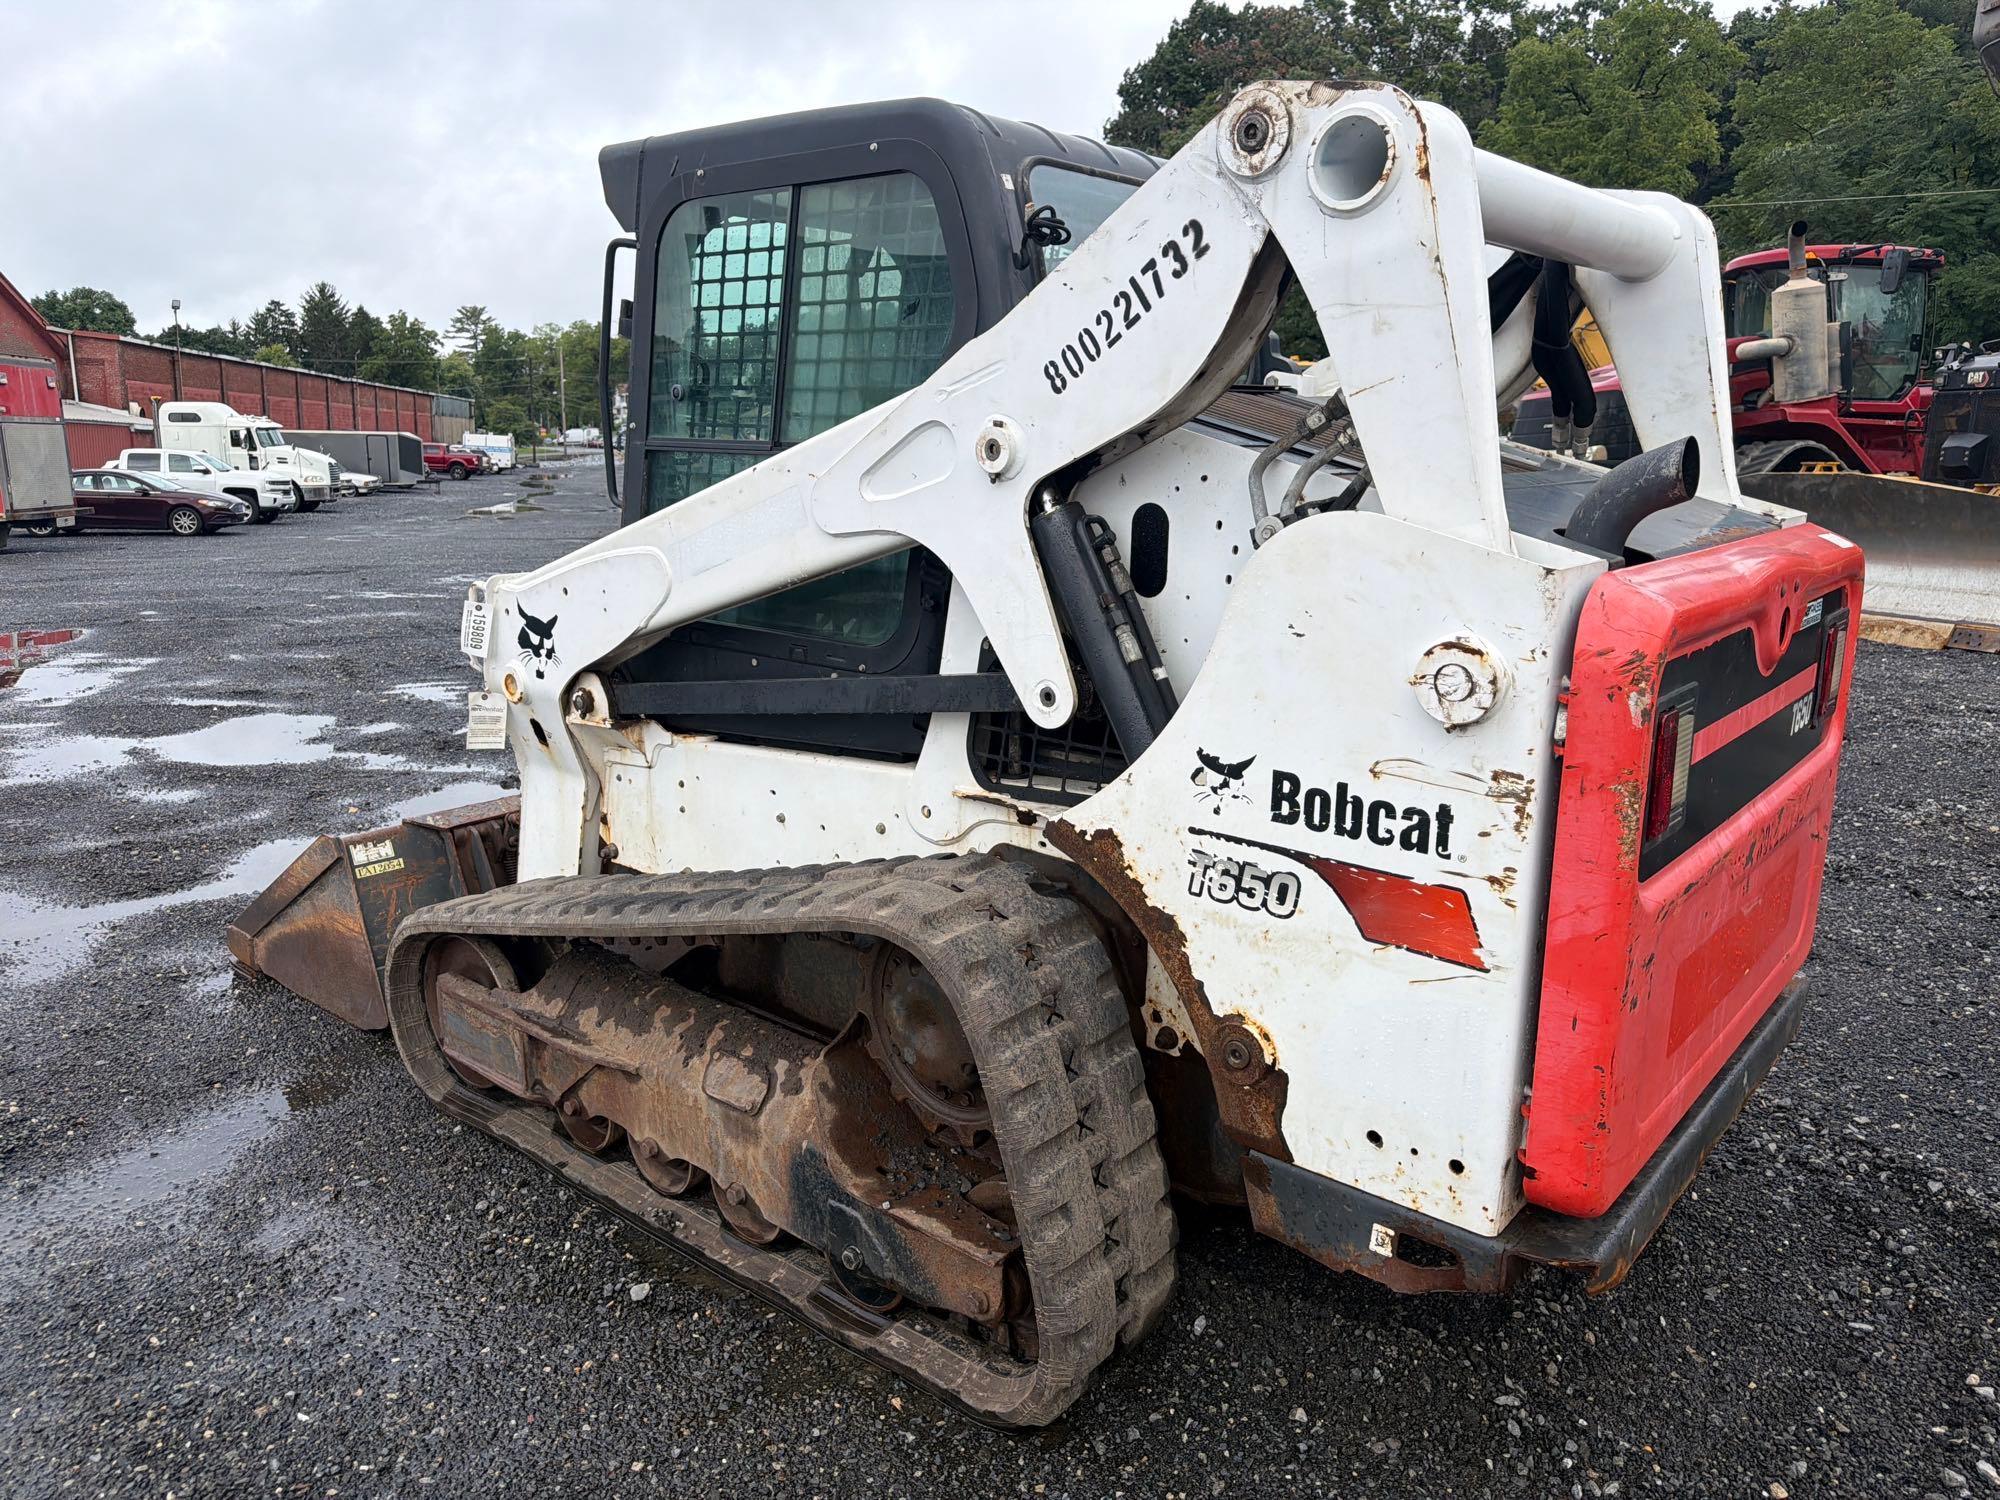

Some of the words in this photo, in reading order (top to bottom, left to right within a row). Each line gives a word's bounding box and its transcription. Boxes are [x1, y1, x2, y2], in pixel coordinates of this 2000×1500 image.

[1043, 218, 1211, 395] 800221732
[1967, 371, 1985, 385] CAT
[470, 613, 487, 650] 159809
[1270, 768, 1455, 860] Bobcat
[1187, 848, 1302, 920] T650
